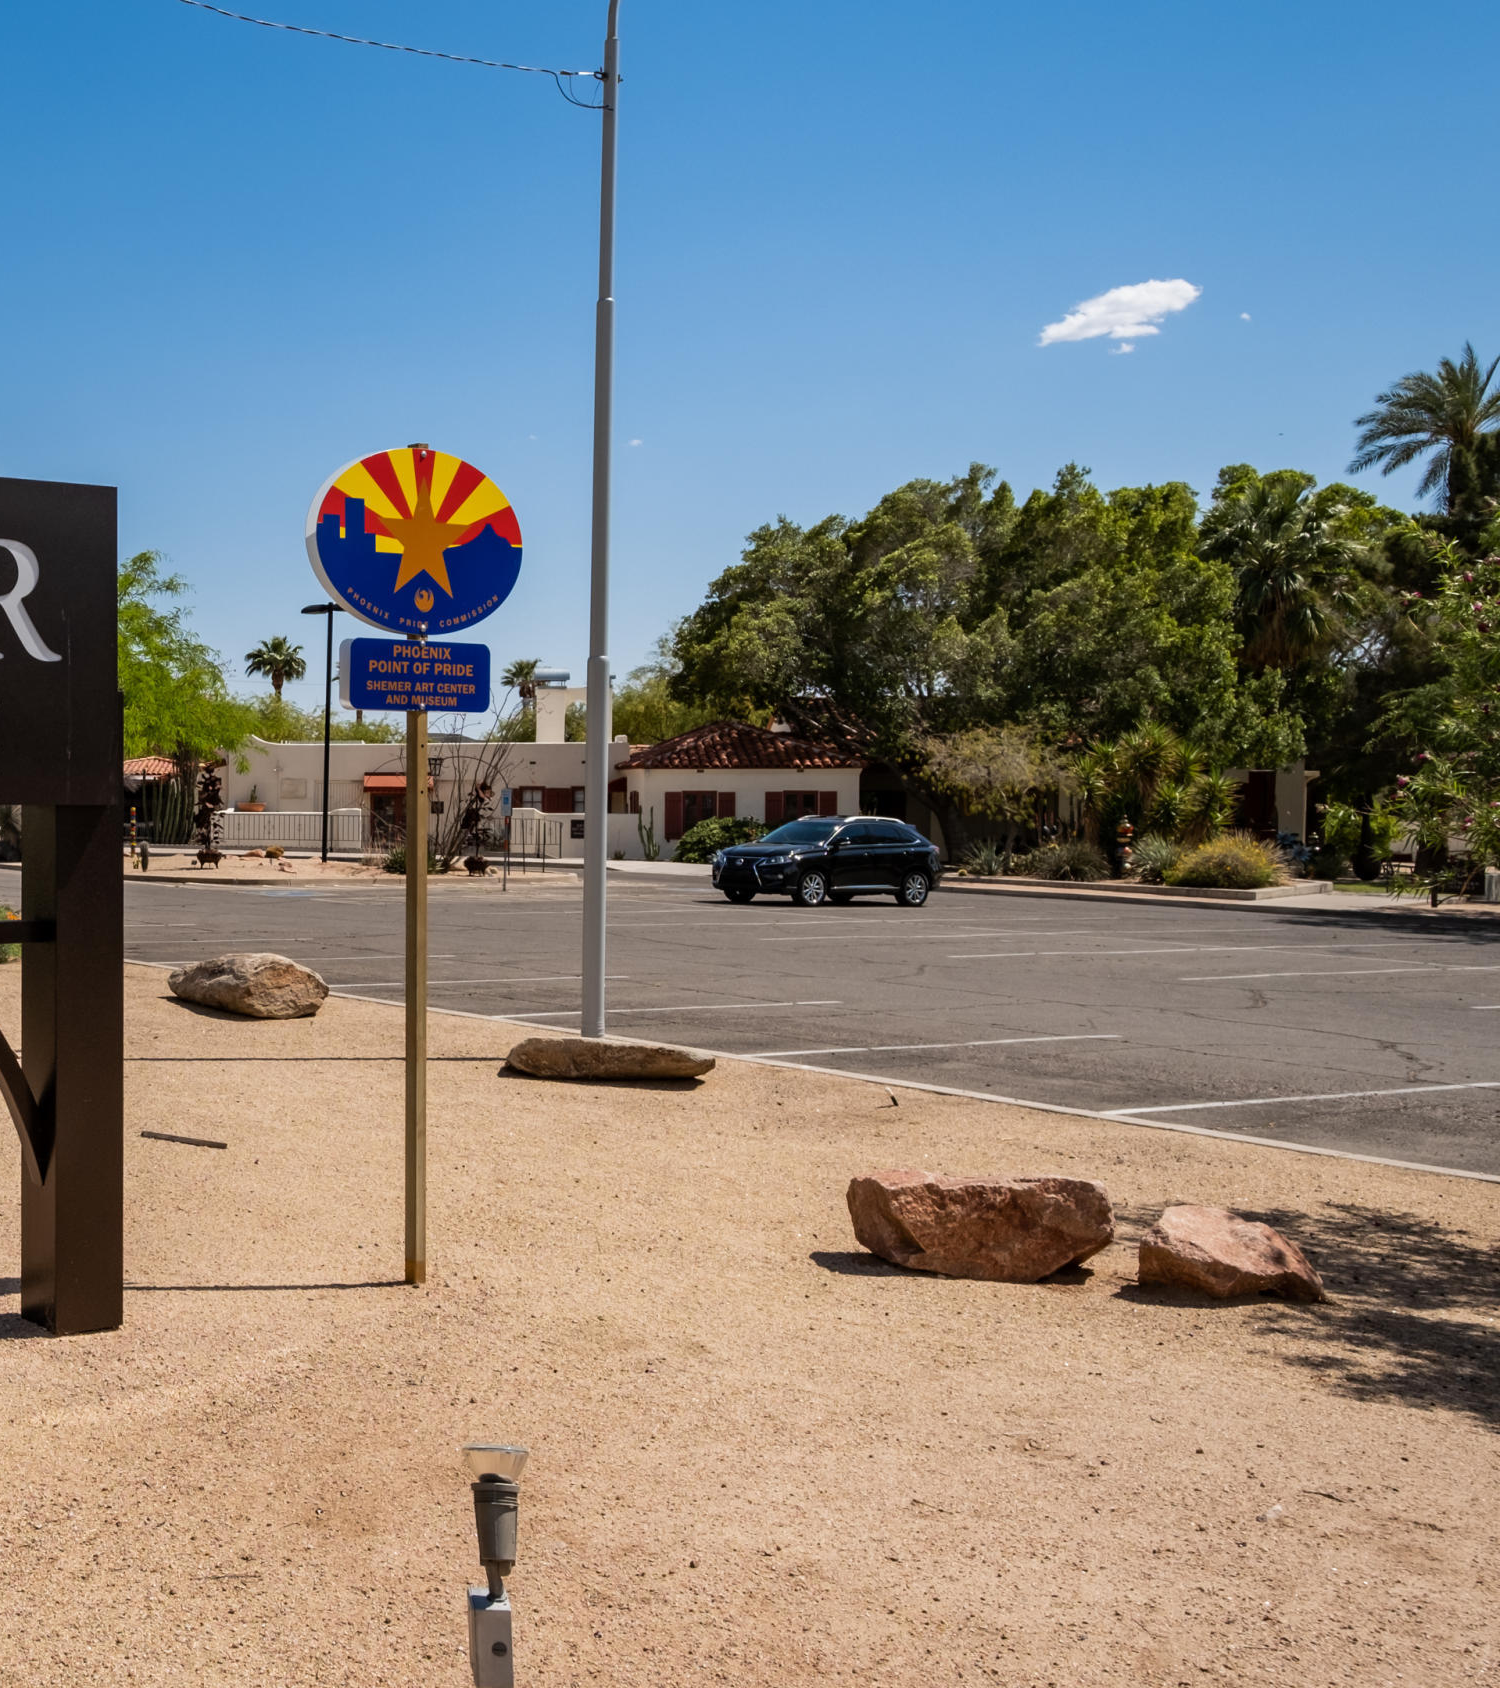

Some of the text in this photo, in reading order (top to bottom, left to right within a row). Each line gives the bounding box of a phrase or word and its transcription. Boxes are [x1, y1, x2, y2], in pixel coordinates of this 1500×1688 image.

[347, 586, 390, 620] PHOENIX
[439, 594, 499, 628] COMMISSION
[393, 644, 452, 660] PHOENIX
[368, 659, 474, 677] POINT OF PRIDE
[366, 680, 476, 695] SHEMER ART CENTER
[385, 694, 458, 707] AND MUSEUM
